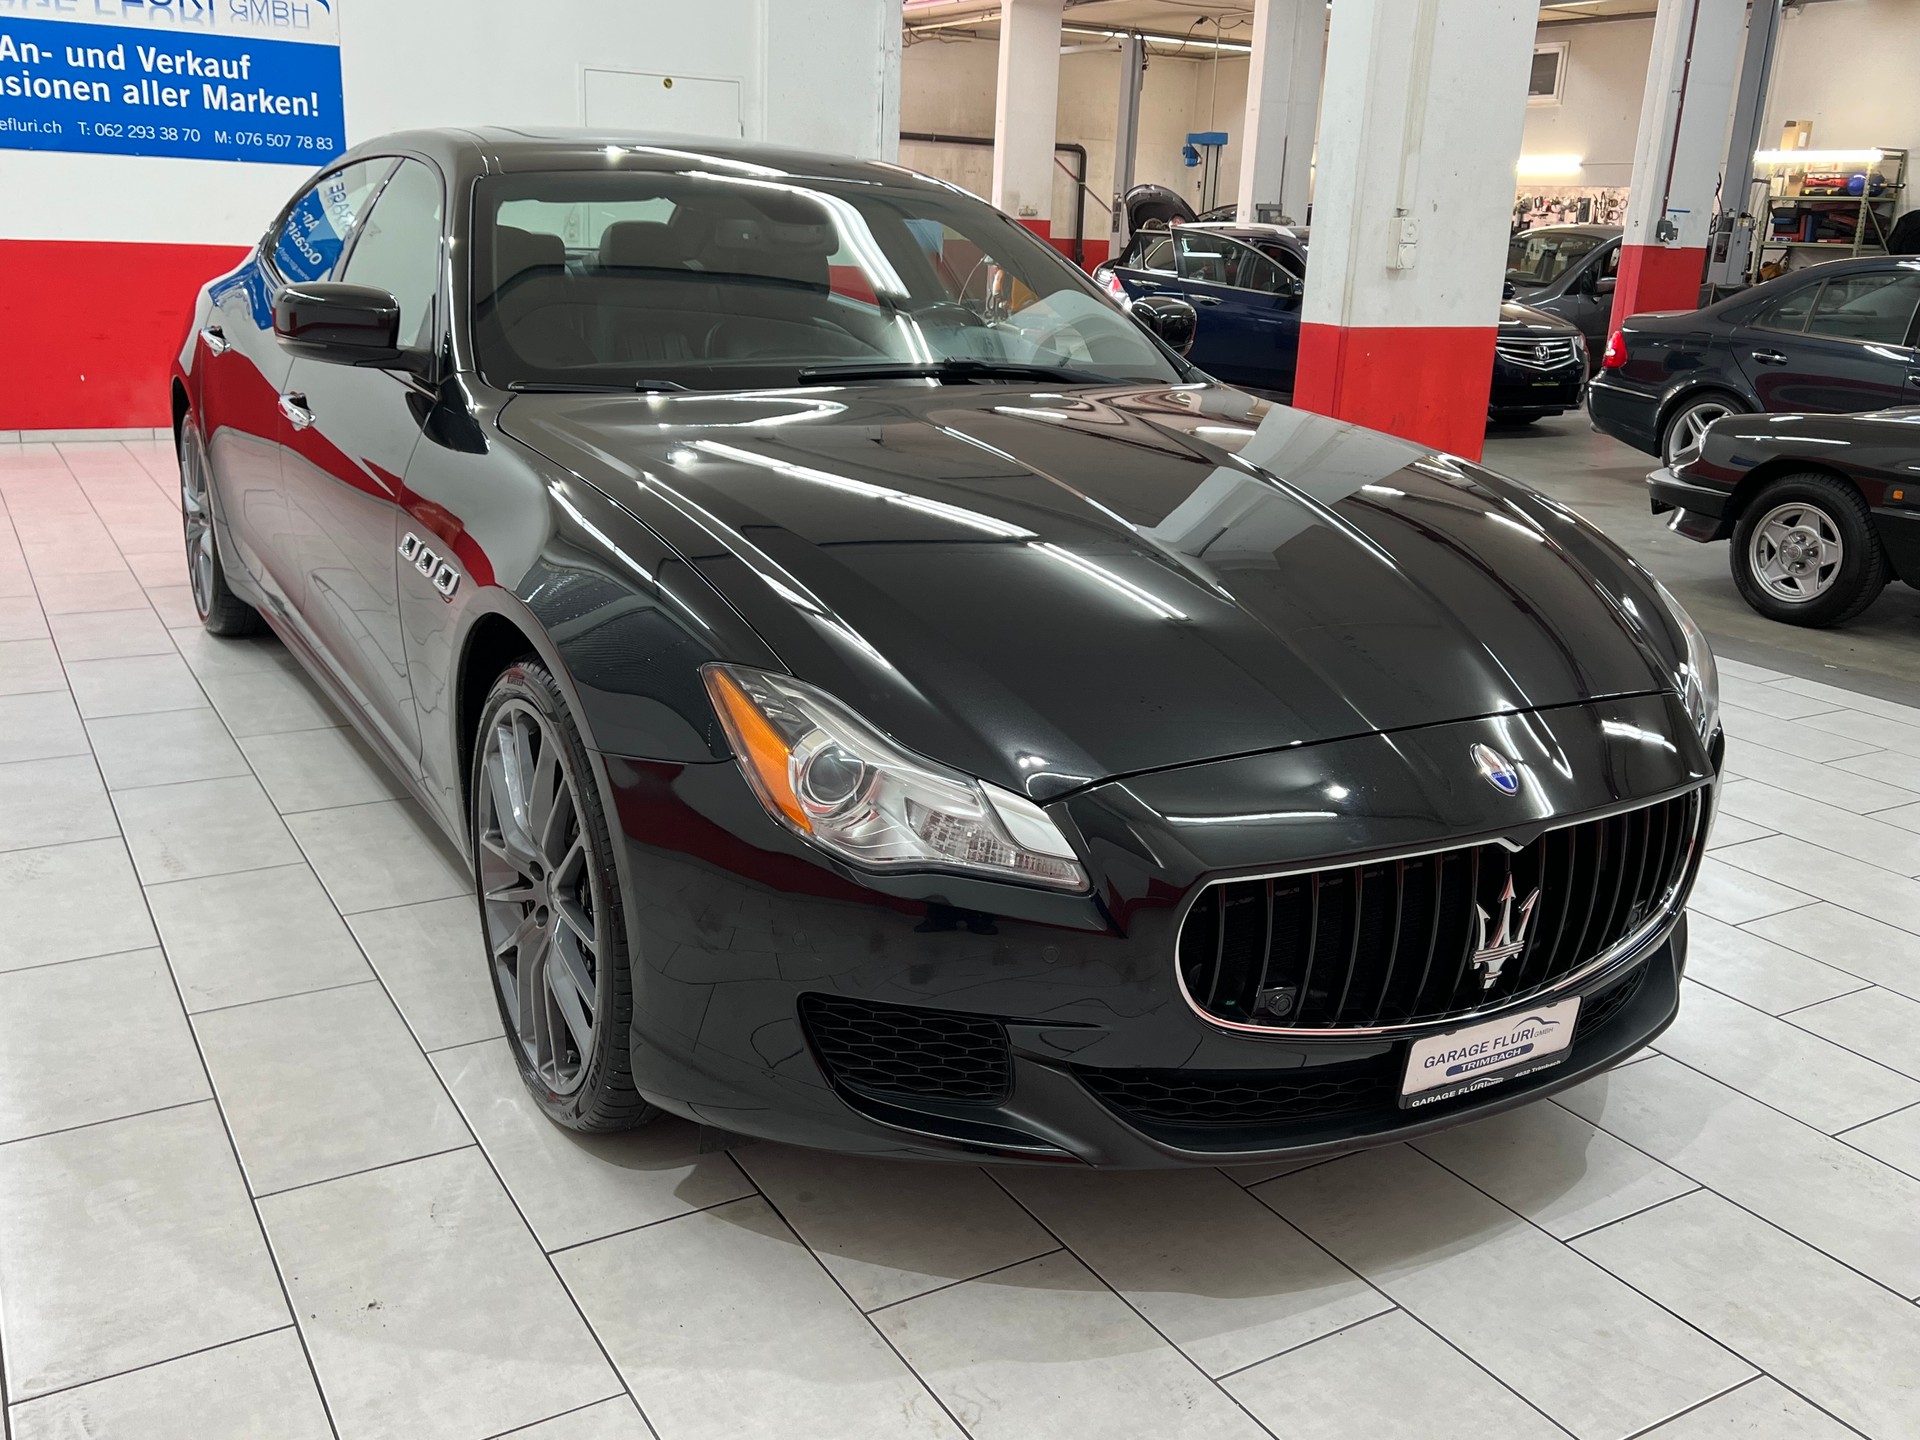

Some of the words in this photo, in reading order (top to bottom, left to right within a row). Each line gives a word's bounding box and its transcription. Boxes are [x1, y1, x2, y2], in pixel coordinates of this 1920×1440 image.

[0, 34, 53, 64] An-
[65, 43, 126, 71] und
[136, 45, 251, 80] Verkauf
[0, 70, 111, 103] sionen
[123, 78, 191, 108] aller
[203, 83, 319, 117] Marken!
[0, 117, 62, 134] efluri.ch
[77, 121, 91, 136] T:
[94, 122, 123, 138] 062
[128, 124, 156, 140] 293
[159, 126, 179, 141] 38
[182, 128, 201, 142] 70
[214, 130, 232, 145] M:
[236, 131, 262, 147] 076
[266, 133, 291, 148] 507
[296, 135, 313, 149] 78
[316, 136, 333, 150] 83
[1424, 1040, 1490, 1069] GARAGE
[1492, 1027, 1535, 1050] FLURI
[1461, 1047, 1522, 1072] TRIMBACH
[1411, 1090, 1456, 1108] GARAGE
[1457, 1081, 1488, 1095] FLURI
